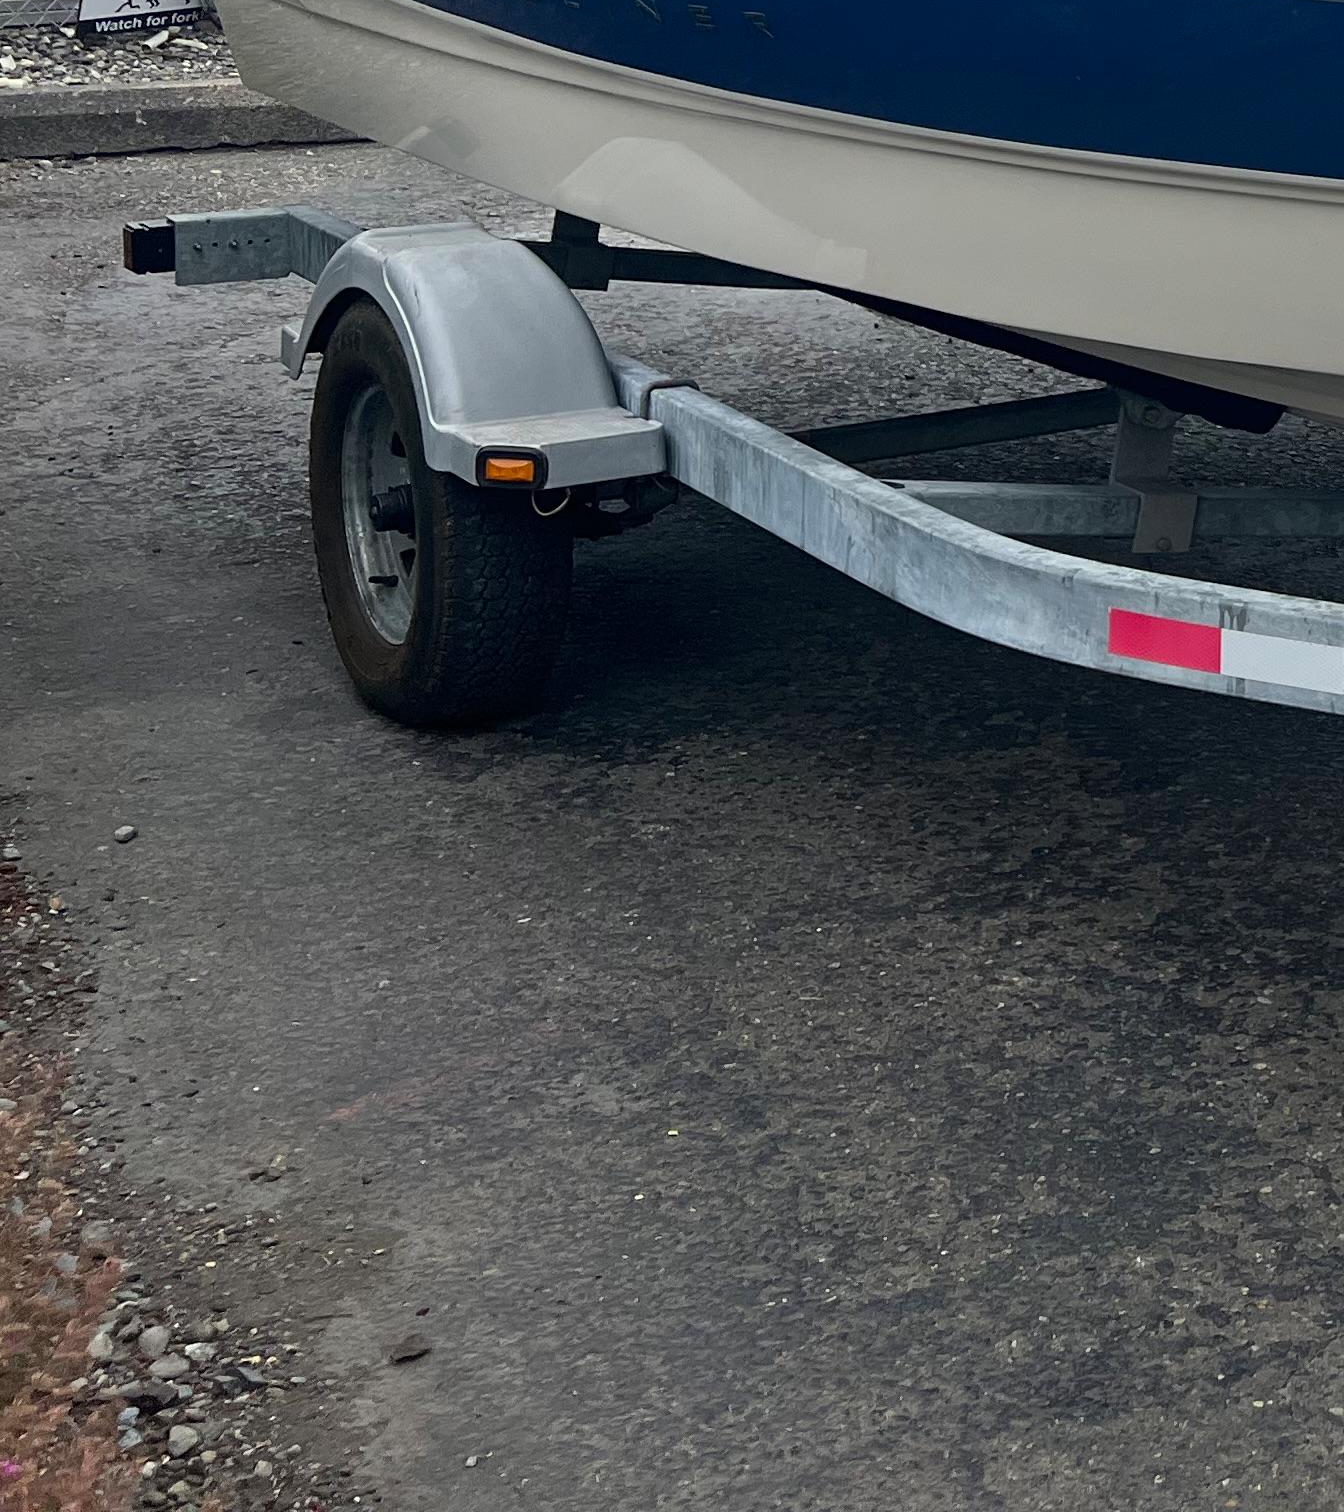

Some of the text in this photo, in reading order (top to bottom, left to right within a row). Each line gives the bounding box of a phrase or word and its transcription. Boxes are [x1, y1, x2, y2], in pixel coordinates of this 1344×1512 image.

[95, 11, 200, 33] Watch for fork
